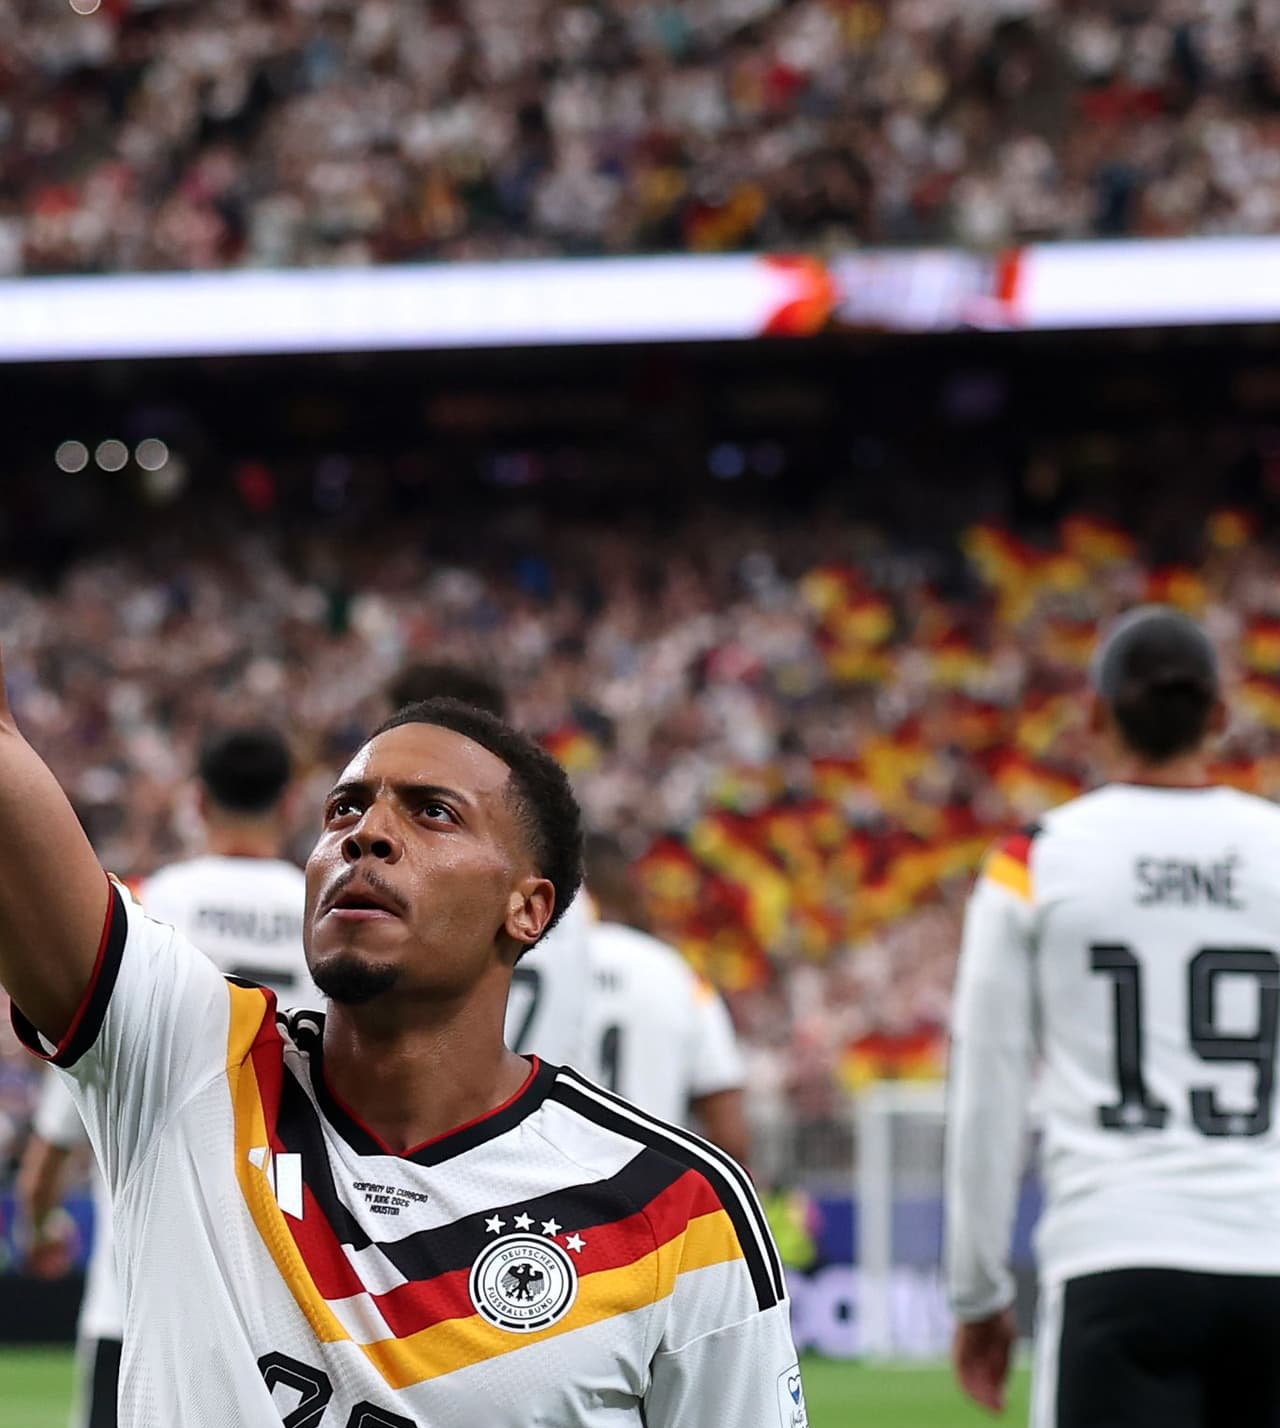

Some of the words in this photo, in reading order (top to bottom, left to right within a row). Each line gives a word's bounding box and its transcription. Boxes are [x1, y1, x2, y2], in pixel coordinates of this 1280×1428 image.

[1135, 850, 1244, 910] SANÉ
[370, 1204, 400, 1216] HOUSTON
[373, 1194, 390, 1205] JUNE
[500, 1248, 556, 1272] DEUTSCHER
[487, 1286, 554, 1317] FUSSBALL-BUND
